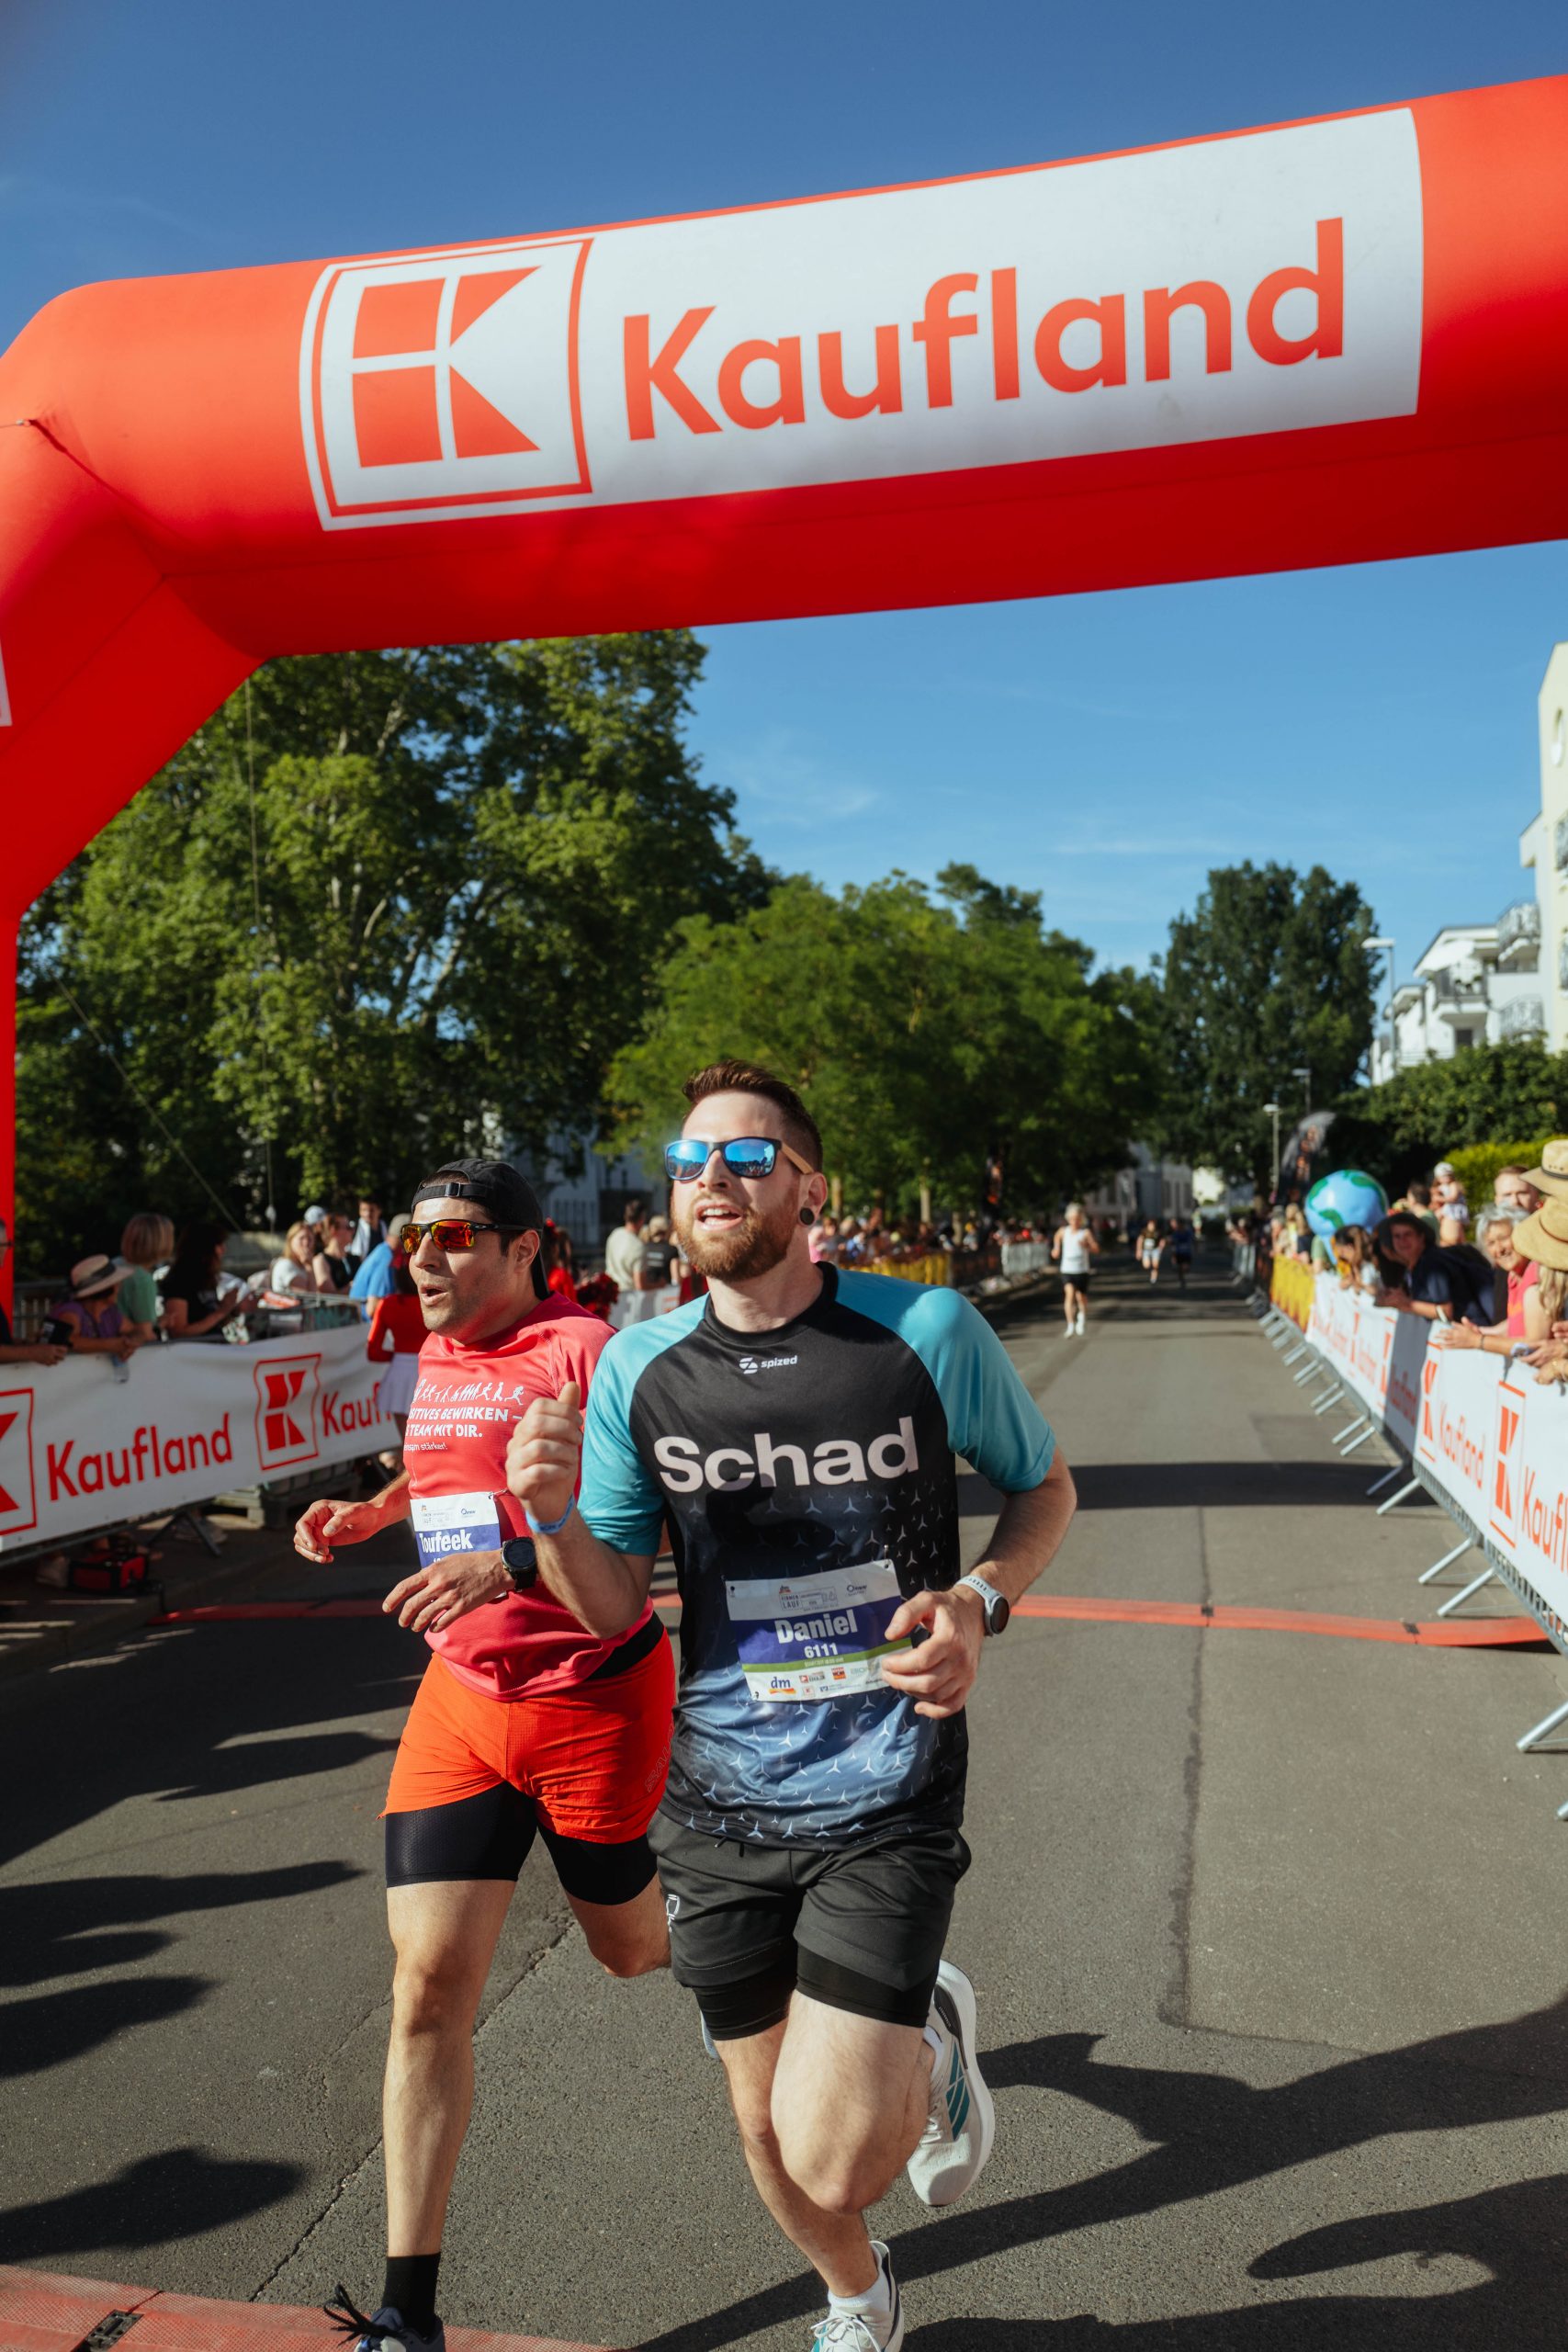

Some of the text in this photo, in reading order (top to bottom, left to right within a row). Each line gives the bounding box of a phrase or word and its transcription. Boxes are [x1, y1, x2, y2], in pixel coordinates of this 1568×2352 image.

[623, 217, 1344, 442] Kaufland
[761, 1355, 798, 1369] spized
[321, 1382, 391, 1438] Kauf
[410, 1424, 433, 1437] TEAM
[434, 1424, 453, 1437] MIT
[456, 1424, 483, 1438] DIR.
[441, 1408, 509, 1421] BEWIRKEN
[46, 1411, 233, 1502] Kaufland
[653, 1416, 919, 1493] Schad
[1438, 1399, 1485, 1490] Kaufland
[1521, 1465, 1568, 1573] Kaufl
[774, 1609, 858, 1645] Daniel
[804, 1643, 839, 1658] 6111
[770, 1677, 792, 1689] dm
